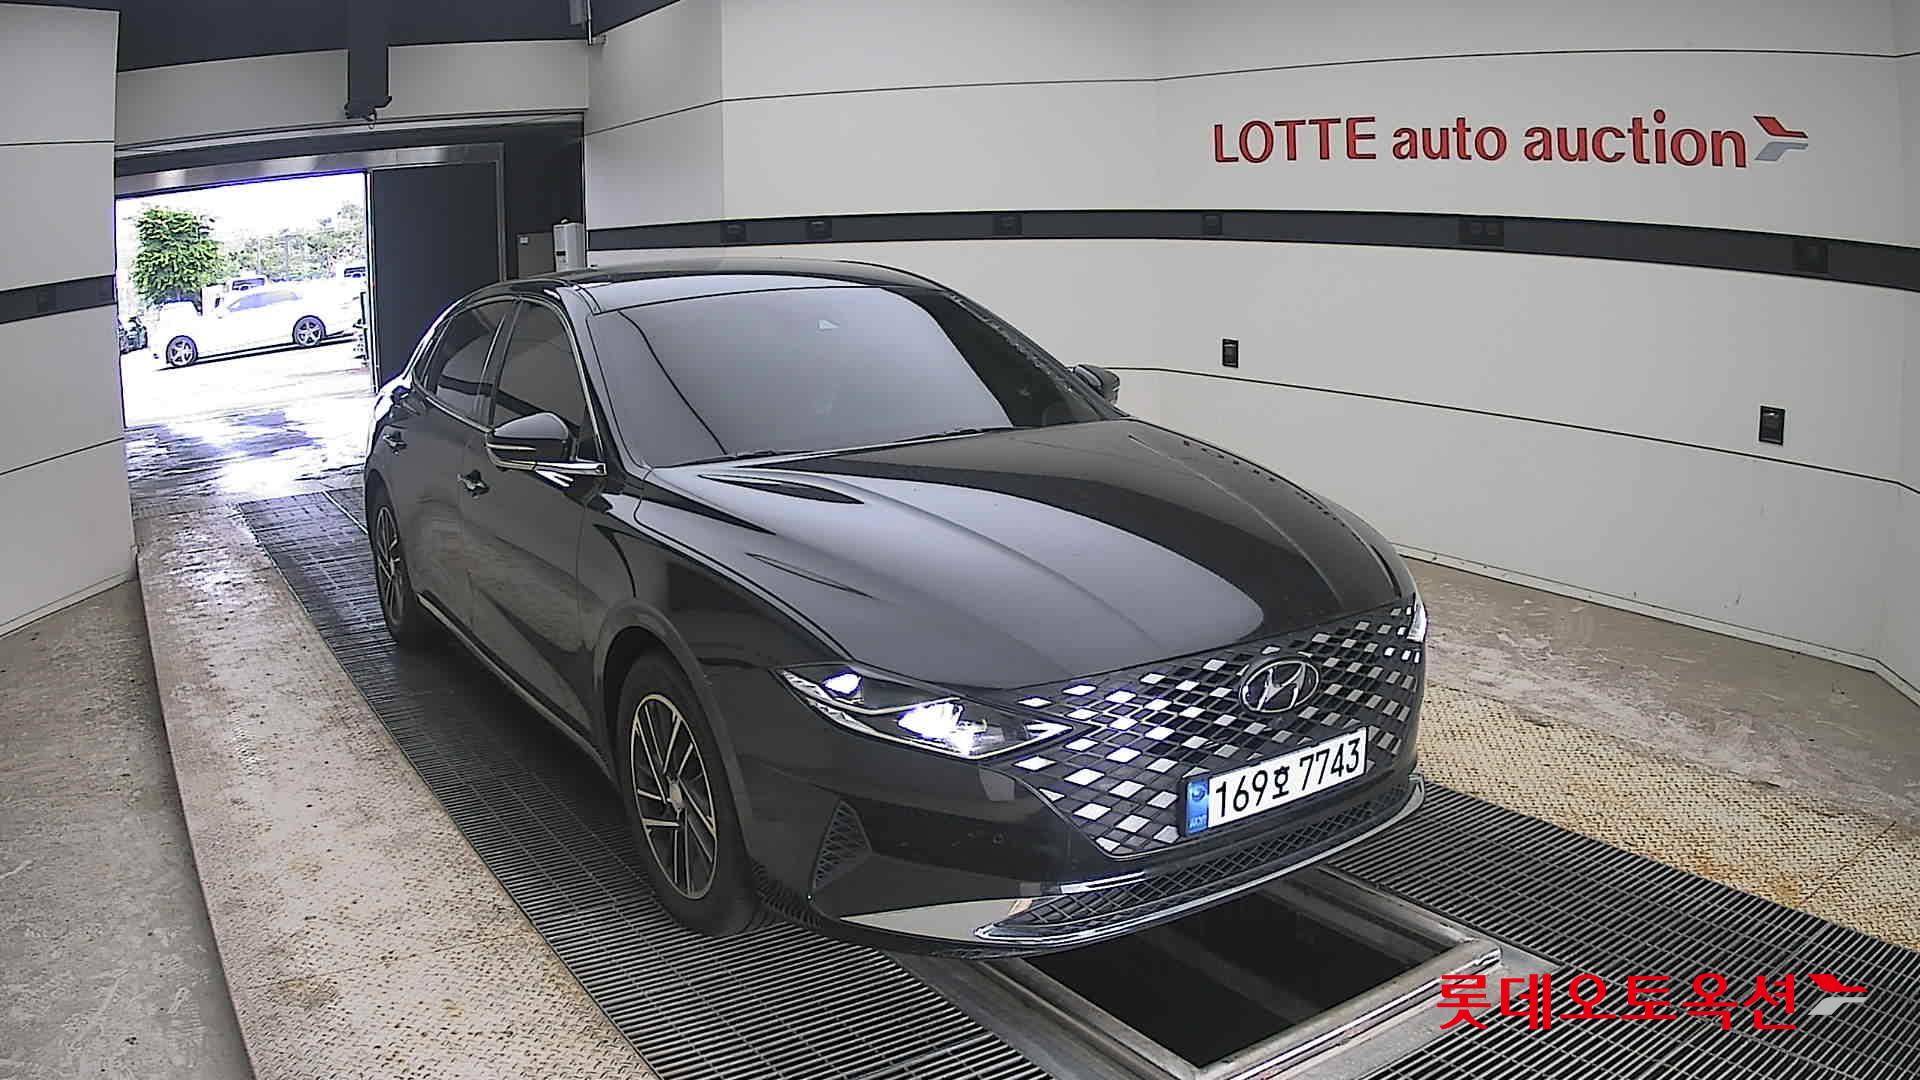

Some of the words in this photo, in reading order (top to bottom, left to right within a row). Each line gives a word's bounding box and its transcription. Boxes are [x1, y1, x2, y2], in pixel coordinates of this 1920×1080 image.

[1213, 116, 1377, 163] LOTTE
[1392, 116, 1507, 161] auto
[1523, 109, 1747, 168] auction
[1215, 765, 1290, 818] 169호
[1299, 738, 1361, 791] 7743
